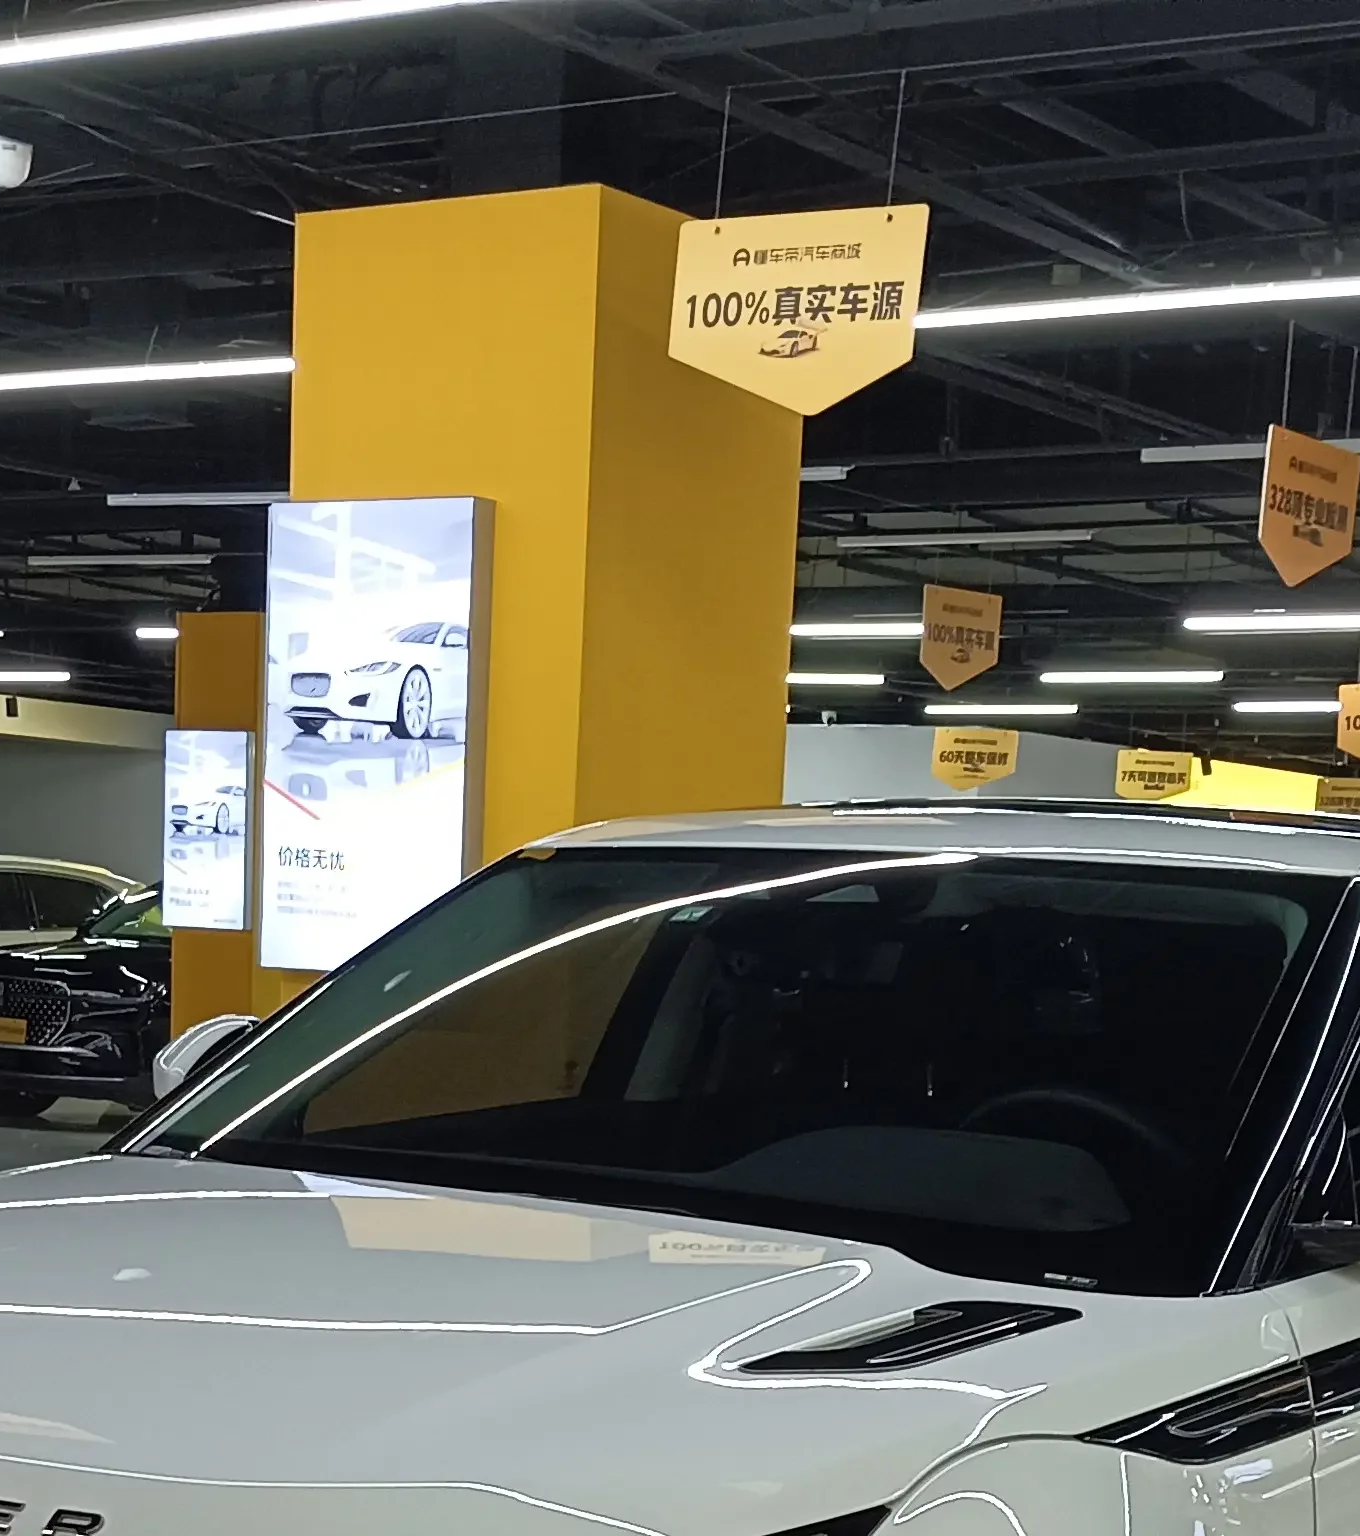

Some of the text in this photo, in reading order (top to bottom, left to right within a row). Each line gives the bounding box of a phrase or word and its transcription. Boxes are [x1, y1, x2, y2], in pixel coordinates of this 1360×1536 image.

[686, 280, 904, 328] 100%真实车源
[278, 845, 345, 871] 价格无忧
